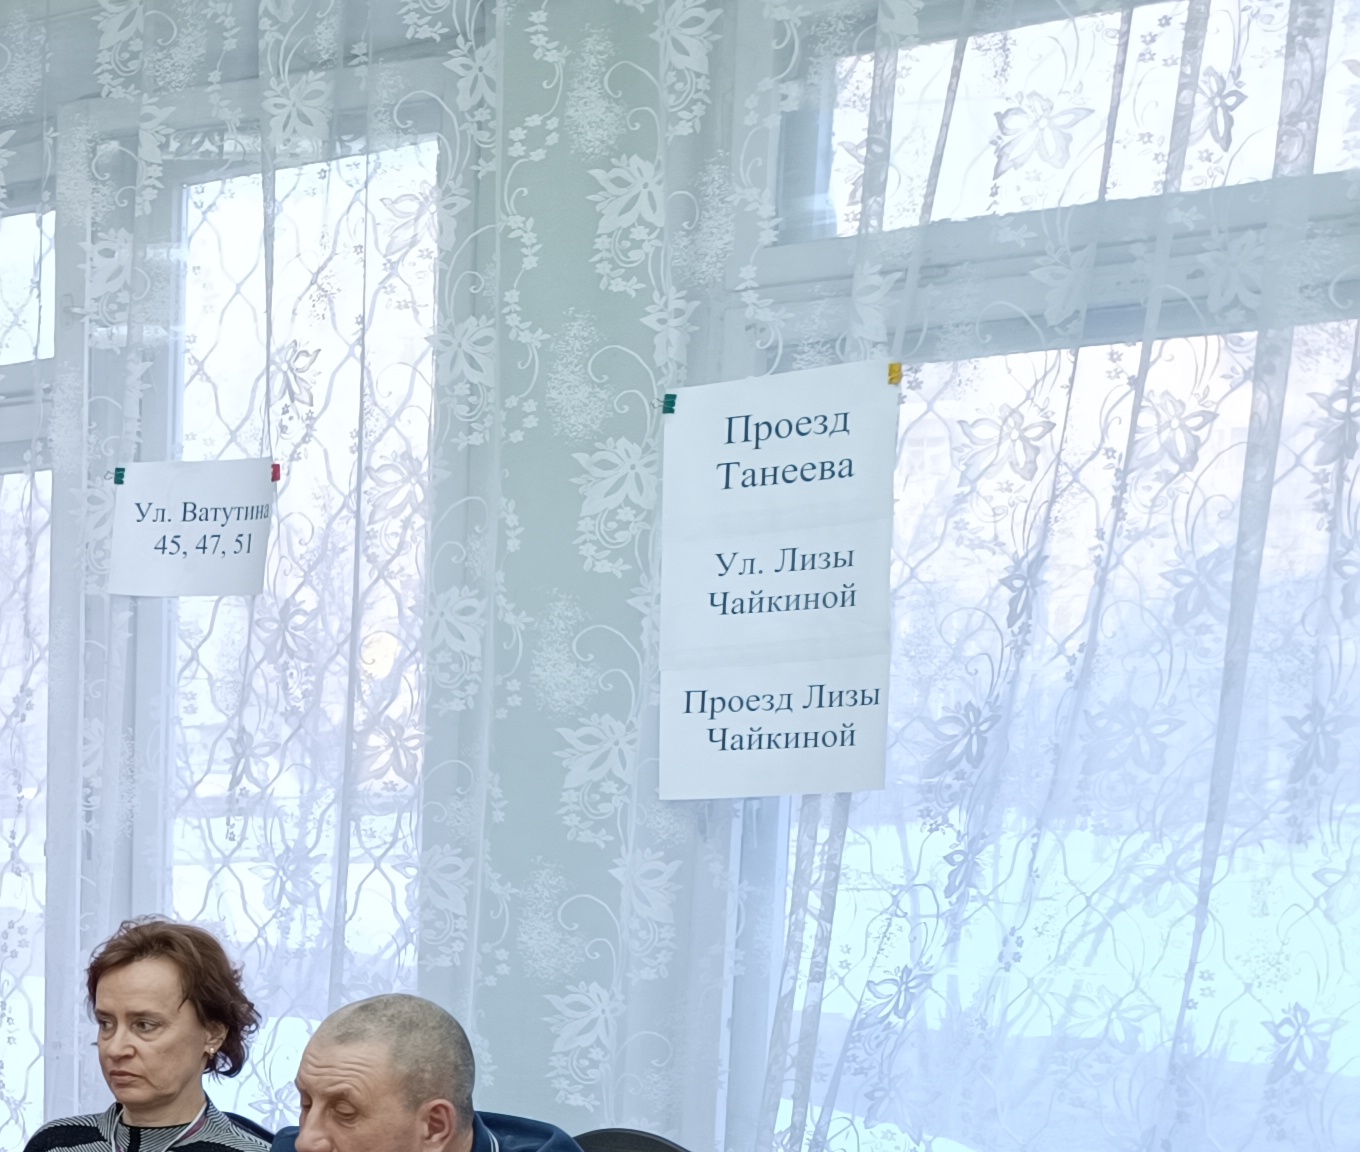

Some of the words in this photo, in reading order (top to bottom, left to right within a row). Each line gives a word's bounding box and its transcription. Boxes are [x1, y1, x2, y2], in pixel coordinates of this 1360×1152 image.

[723, 410, 851, 450] Проезд
[716, 456, 855, 491] Танеева
[134, 501, 172, 523] Ул.
[180, 501, 271, 527] Ватутина
[153, 534, 188, 560] 45,
[195, 534, 226, 559] 47,
[233, 533, 252, 554] 51
[714, 550, 764, 577] Ул.
[774, 547, 855, 574] Лизы
[708, 582, 857, 617] Чайкиной
[682, 688, 794, 721] Проезд
[802, 683, 882, 711] Лизы
[707, 722, 856, 752] Чайкиной
